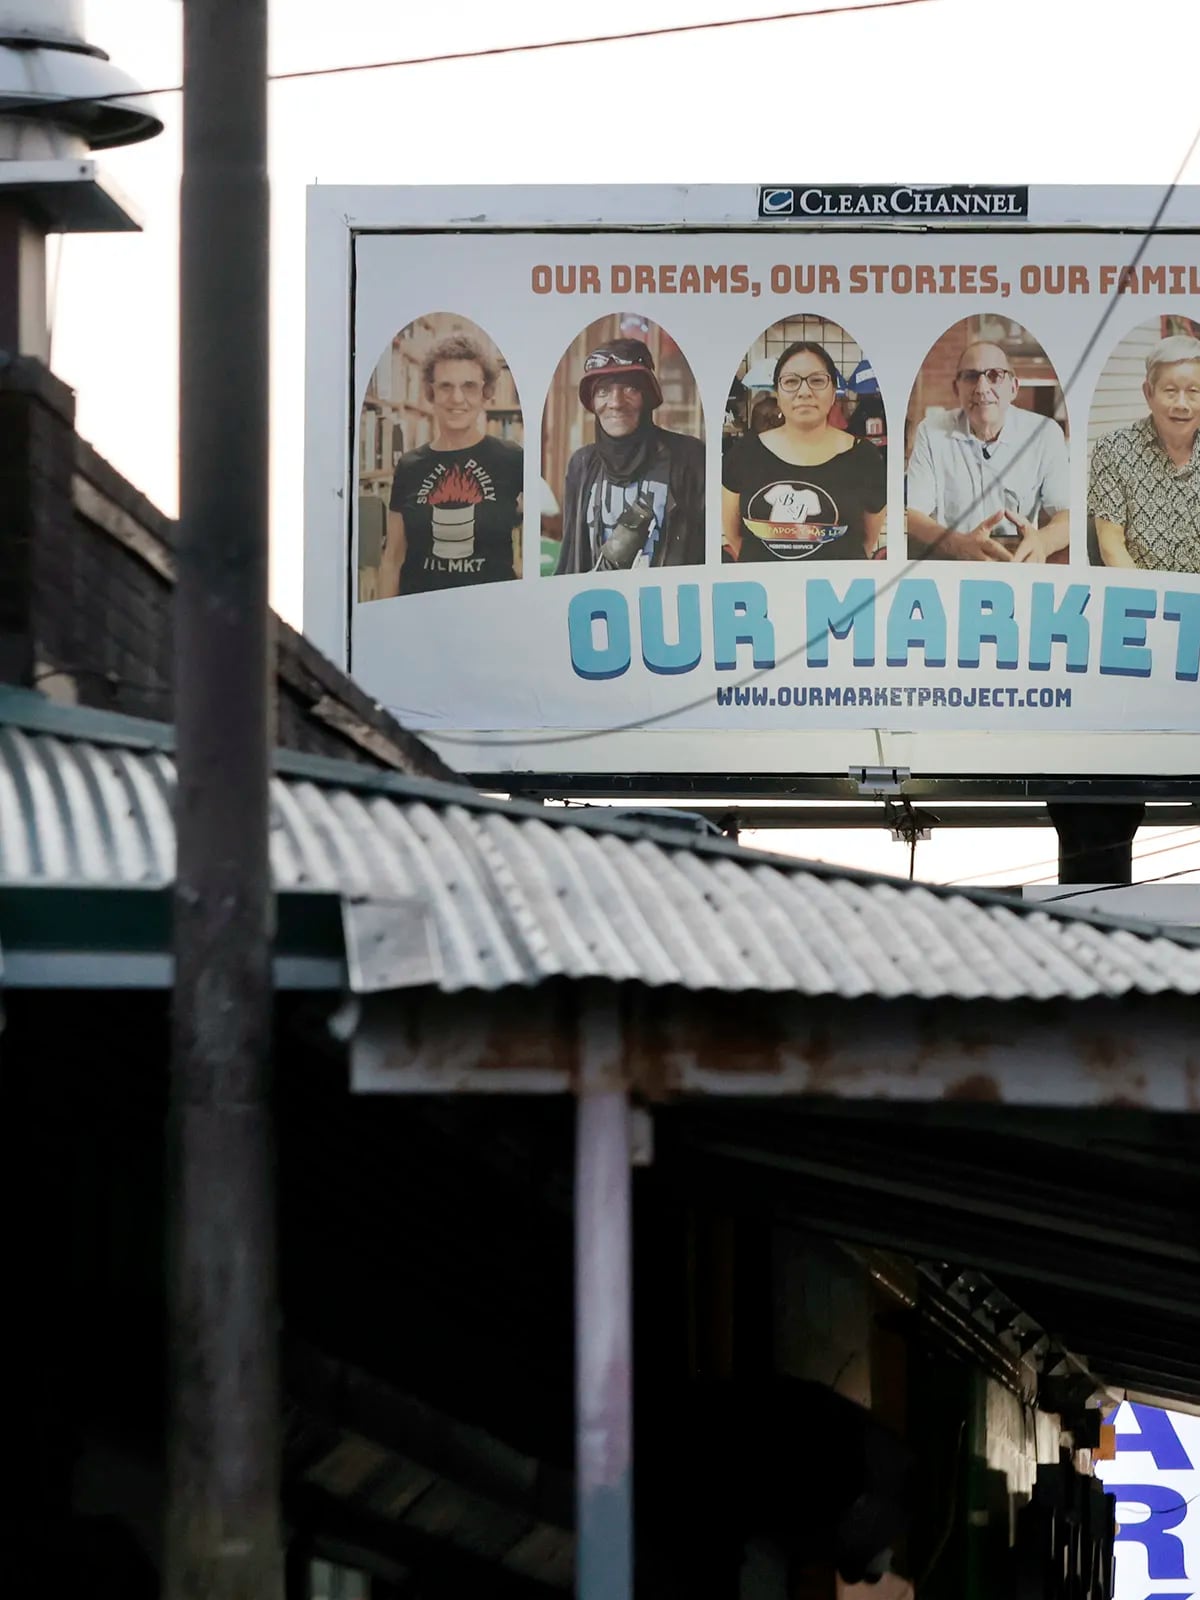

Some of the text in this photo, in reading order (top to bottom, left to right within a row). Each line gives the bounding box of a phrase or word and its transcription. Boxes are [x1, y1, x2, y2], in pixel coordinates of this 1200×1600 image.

[531, 264, 600, 294] OUR
[611, 264, 761, 297] DREAMS,
[770, 264, 840, 294] OUR
[849, 264, 1010, 297] STORIES,
[1020, 264, 1089, 294] OUR
[416, 458, 497, 505] SOUTH PHILLY
[568, 580, 775, 680] OUR
[717, 686, 1072, 708] WWW.OURMARKETPROJECT.COM
